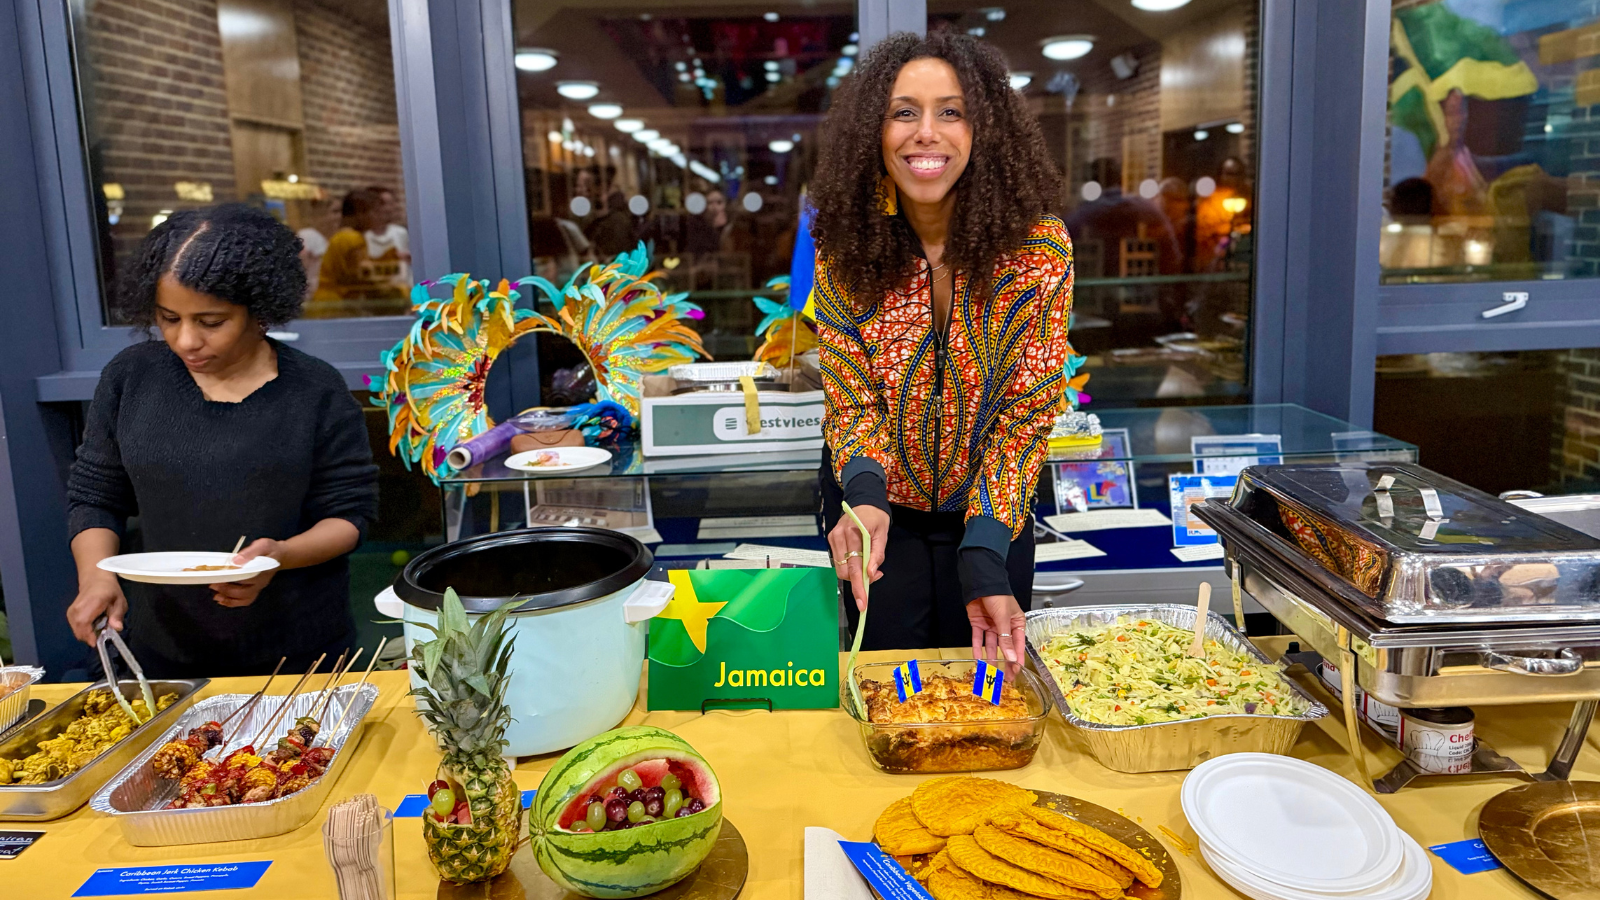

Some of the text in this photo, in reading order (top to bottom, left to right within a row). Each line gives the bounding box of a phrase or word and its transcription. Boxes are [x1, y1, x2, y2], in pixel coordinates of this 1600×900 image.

[746, 416, 820, 428] estvlees
[714, 661, 825, 687] Jamaica
[119, 869, 161, 877] Caribbean
[180, 867, 212, 875] Chicken
[212, 865, 239, 873] Kebab
